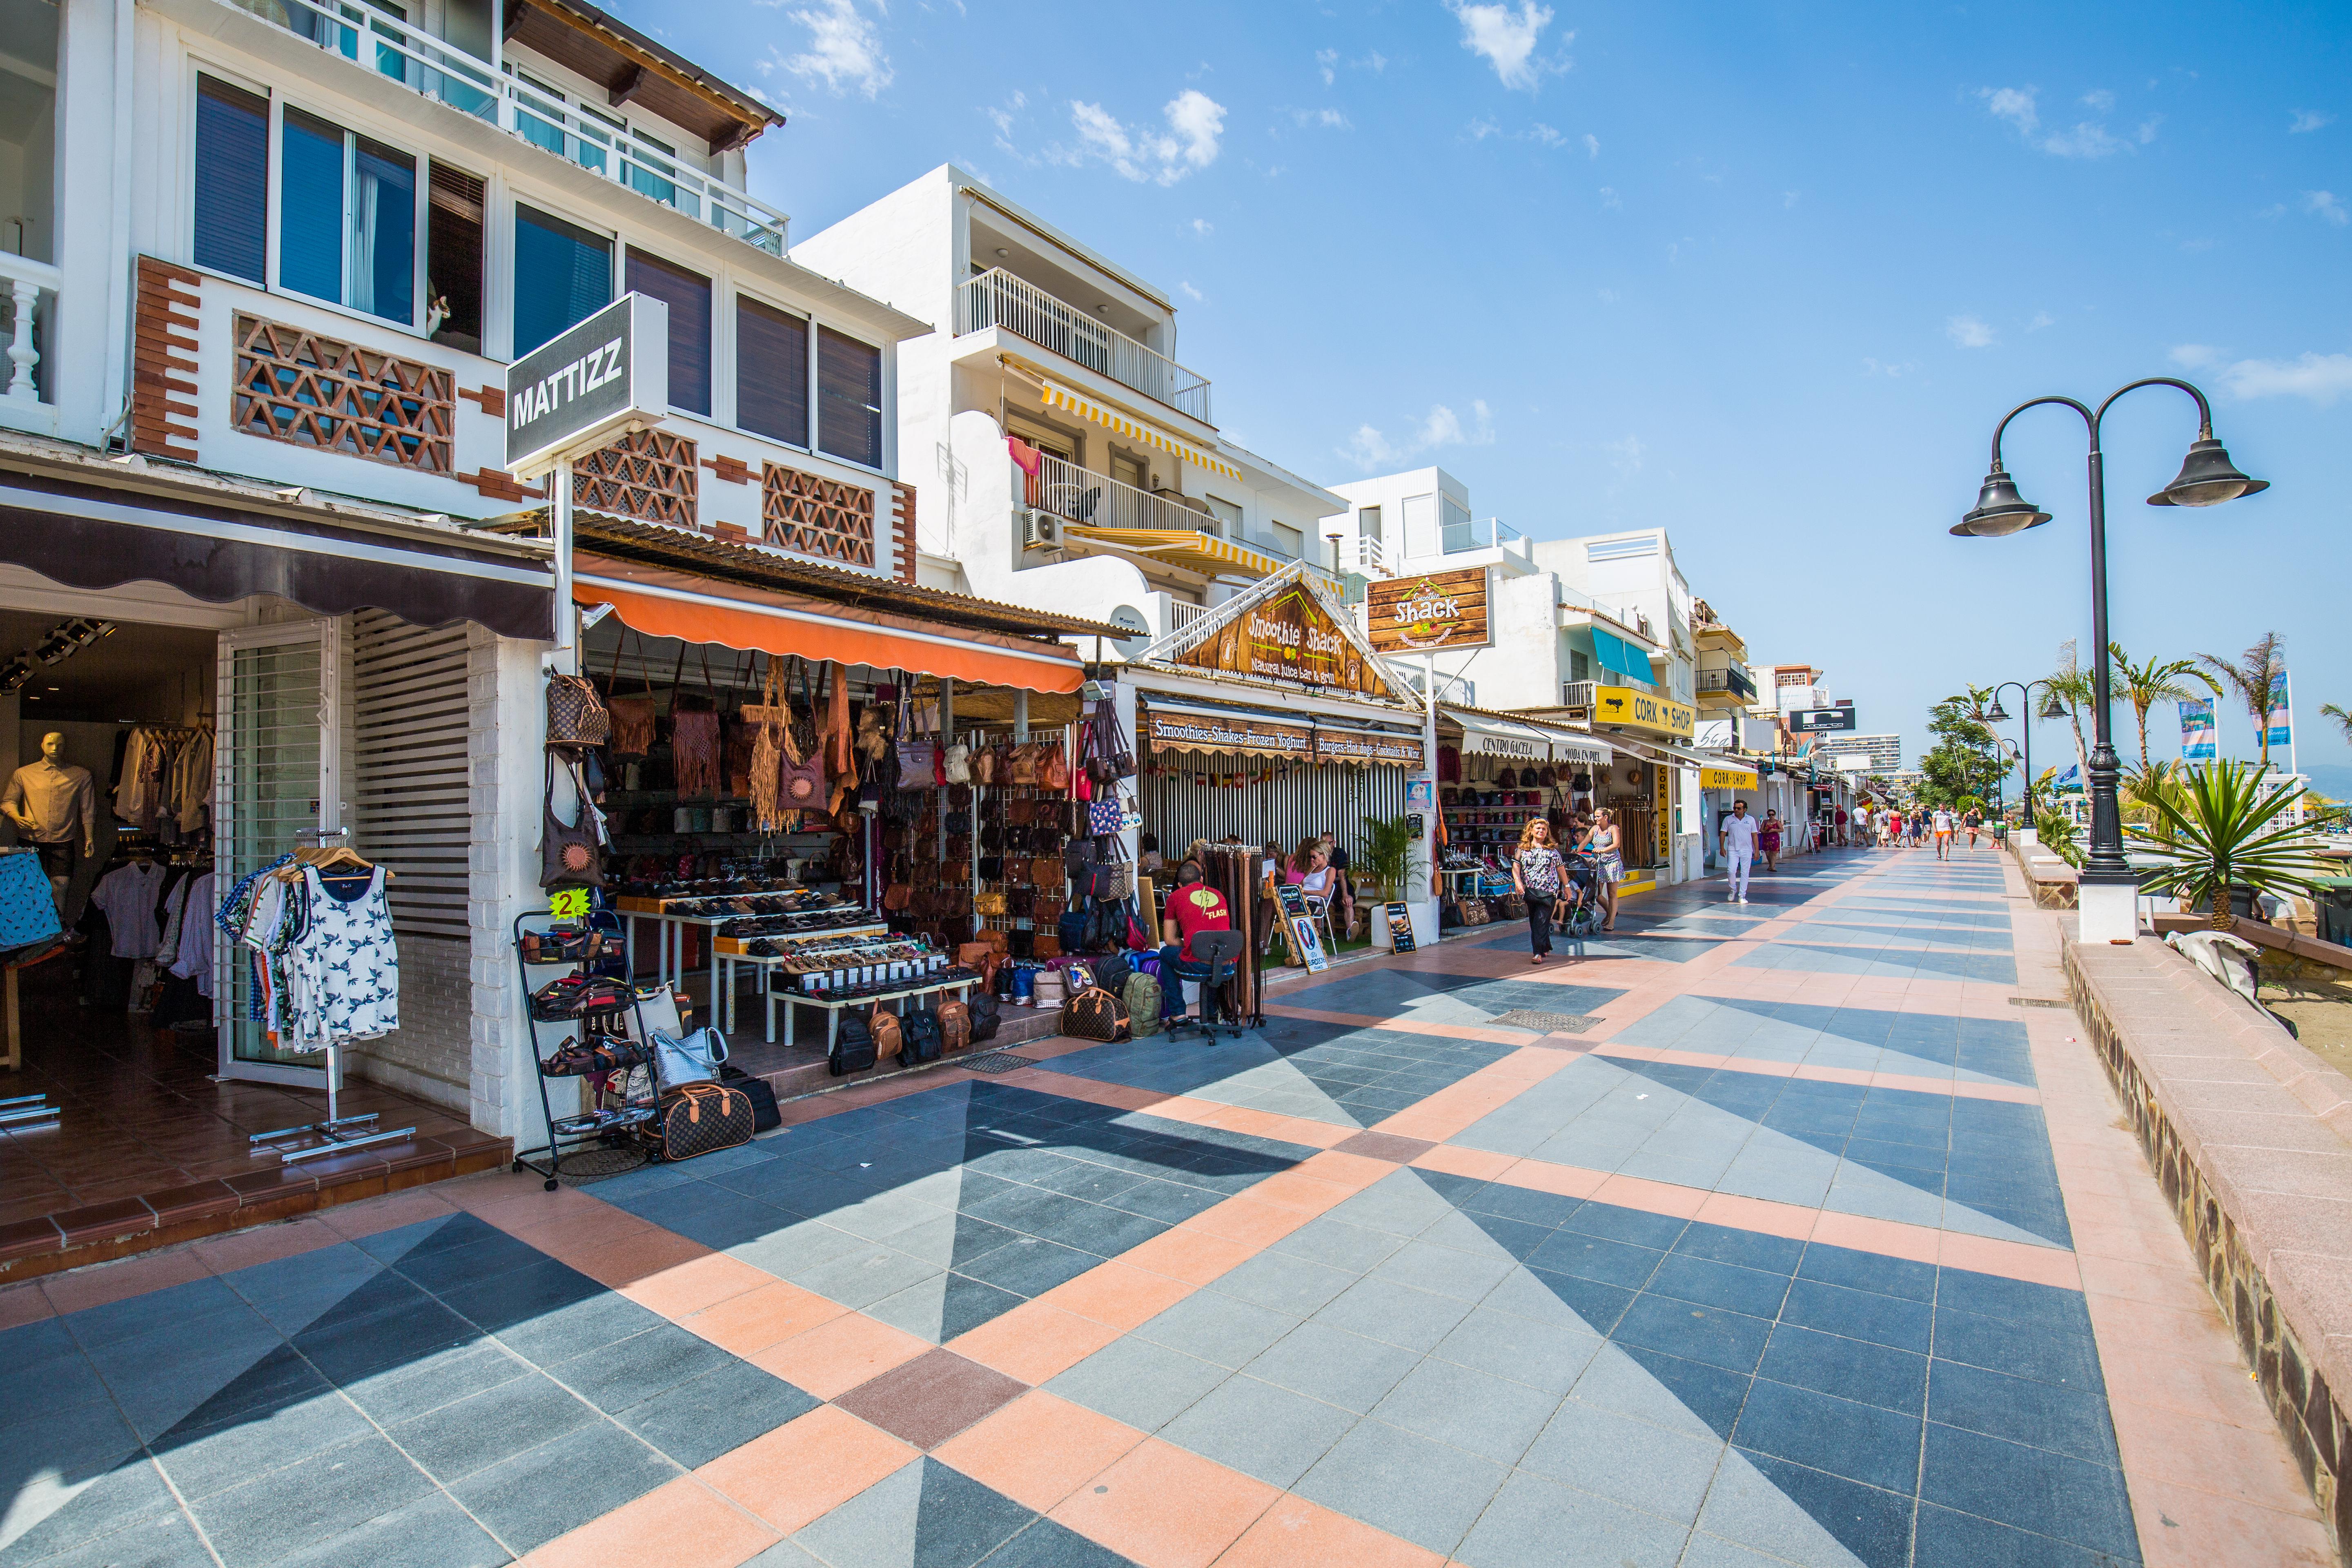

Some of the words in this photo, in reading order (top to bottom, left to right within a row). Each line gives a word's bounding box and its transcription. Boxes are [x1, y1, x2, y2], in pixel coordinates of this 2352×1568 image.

[514, 336, 621, 430] MATTIZZ
[1412, 591, 1440, 602] Smoothie
[1394, 598, 1460, 623] Shack
[1248, 612, 1300, 646] Smoothie
[1306, 627, 1342, 655] Shack
[1251, 657, 1280, 675] Natural
[1281, 663, 1298, 679] juice
[1299, 666, 1312, 680] bar
[1320, 671, 1335, 684] grill
[1635, 697, 1658, 724] CORK
[1671, 707, 1690, 731] SHOP
[1276, 732, 1307, 751] Yoghurt
[1483, 737, 1509, 752] CENTRO
[1510, 740, 1532, 755] GACELA
[1401, 746, 1406, 757] &
[1407, 746, 1419, 759] Wine
[1565, 748, 1580, 760] MODA
[1581, 750, 1588, 761] EN
[1589, 751, 1601, 762] PIEL
[1714, 771, 1729, 784] CORK
[1733, 773, 1746, 786] SHOP
[1209, 909, 1227, 920] FLASH
[1307, 957, 1326, 966] EURO2016
